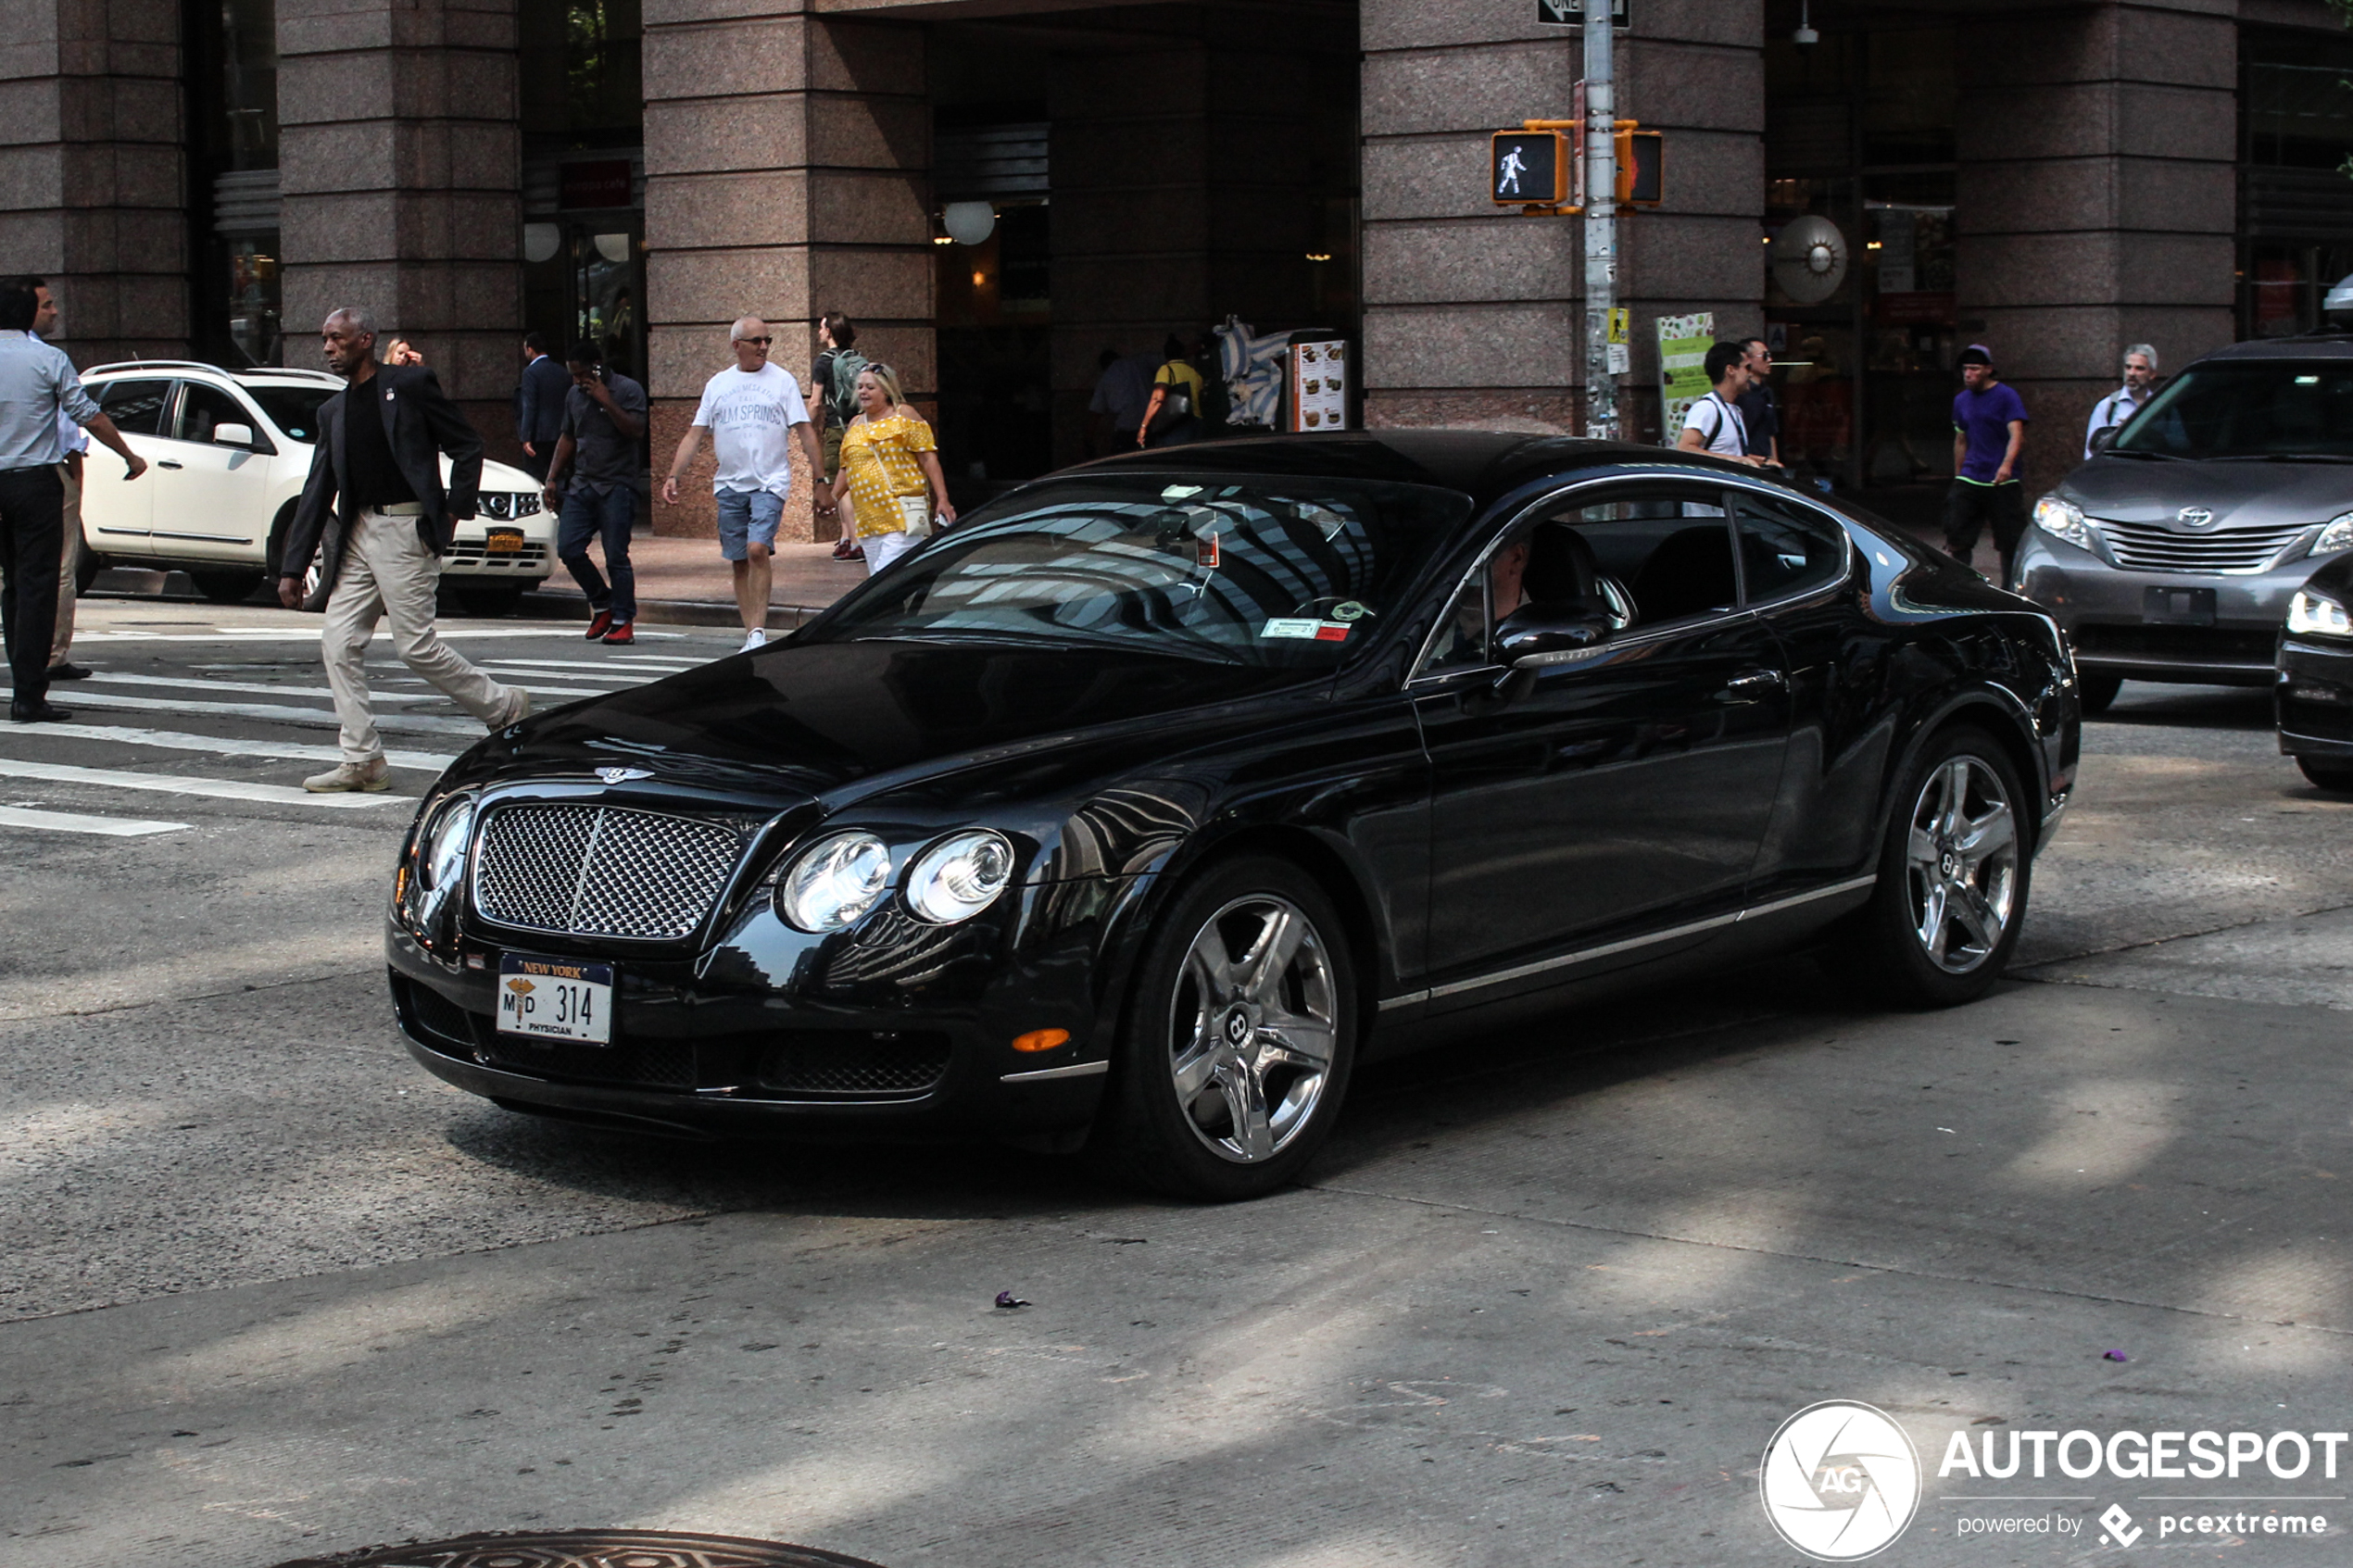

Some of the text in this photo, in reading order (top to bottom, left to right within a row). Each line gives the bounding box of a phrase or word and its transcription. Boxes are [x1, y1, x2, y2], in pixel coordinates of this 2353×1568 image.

[1552, 0, 1579, 9] ONE
[740, 404, 781, 425] SPRINGS
[523, 961, 582, 979] NEW YORK
[504, 985, 592, 1025] M D 314
[529, 1022, 572, 1035] PHYSICIAN
